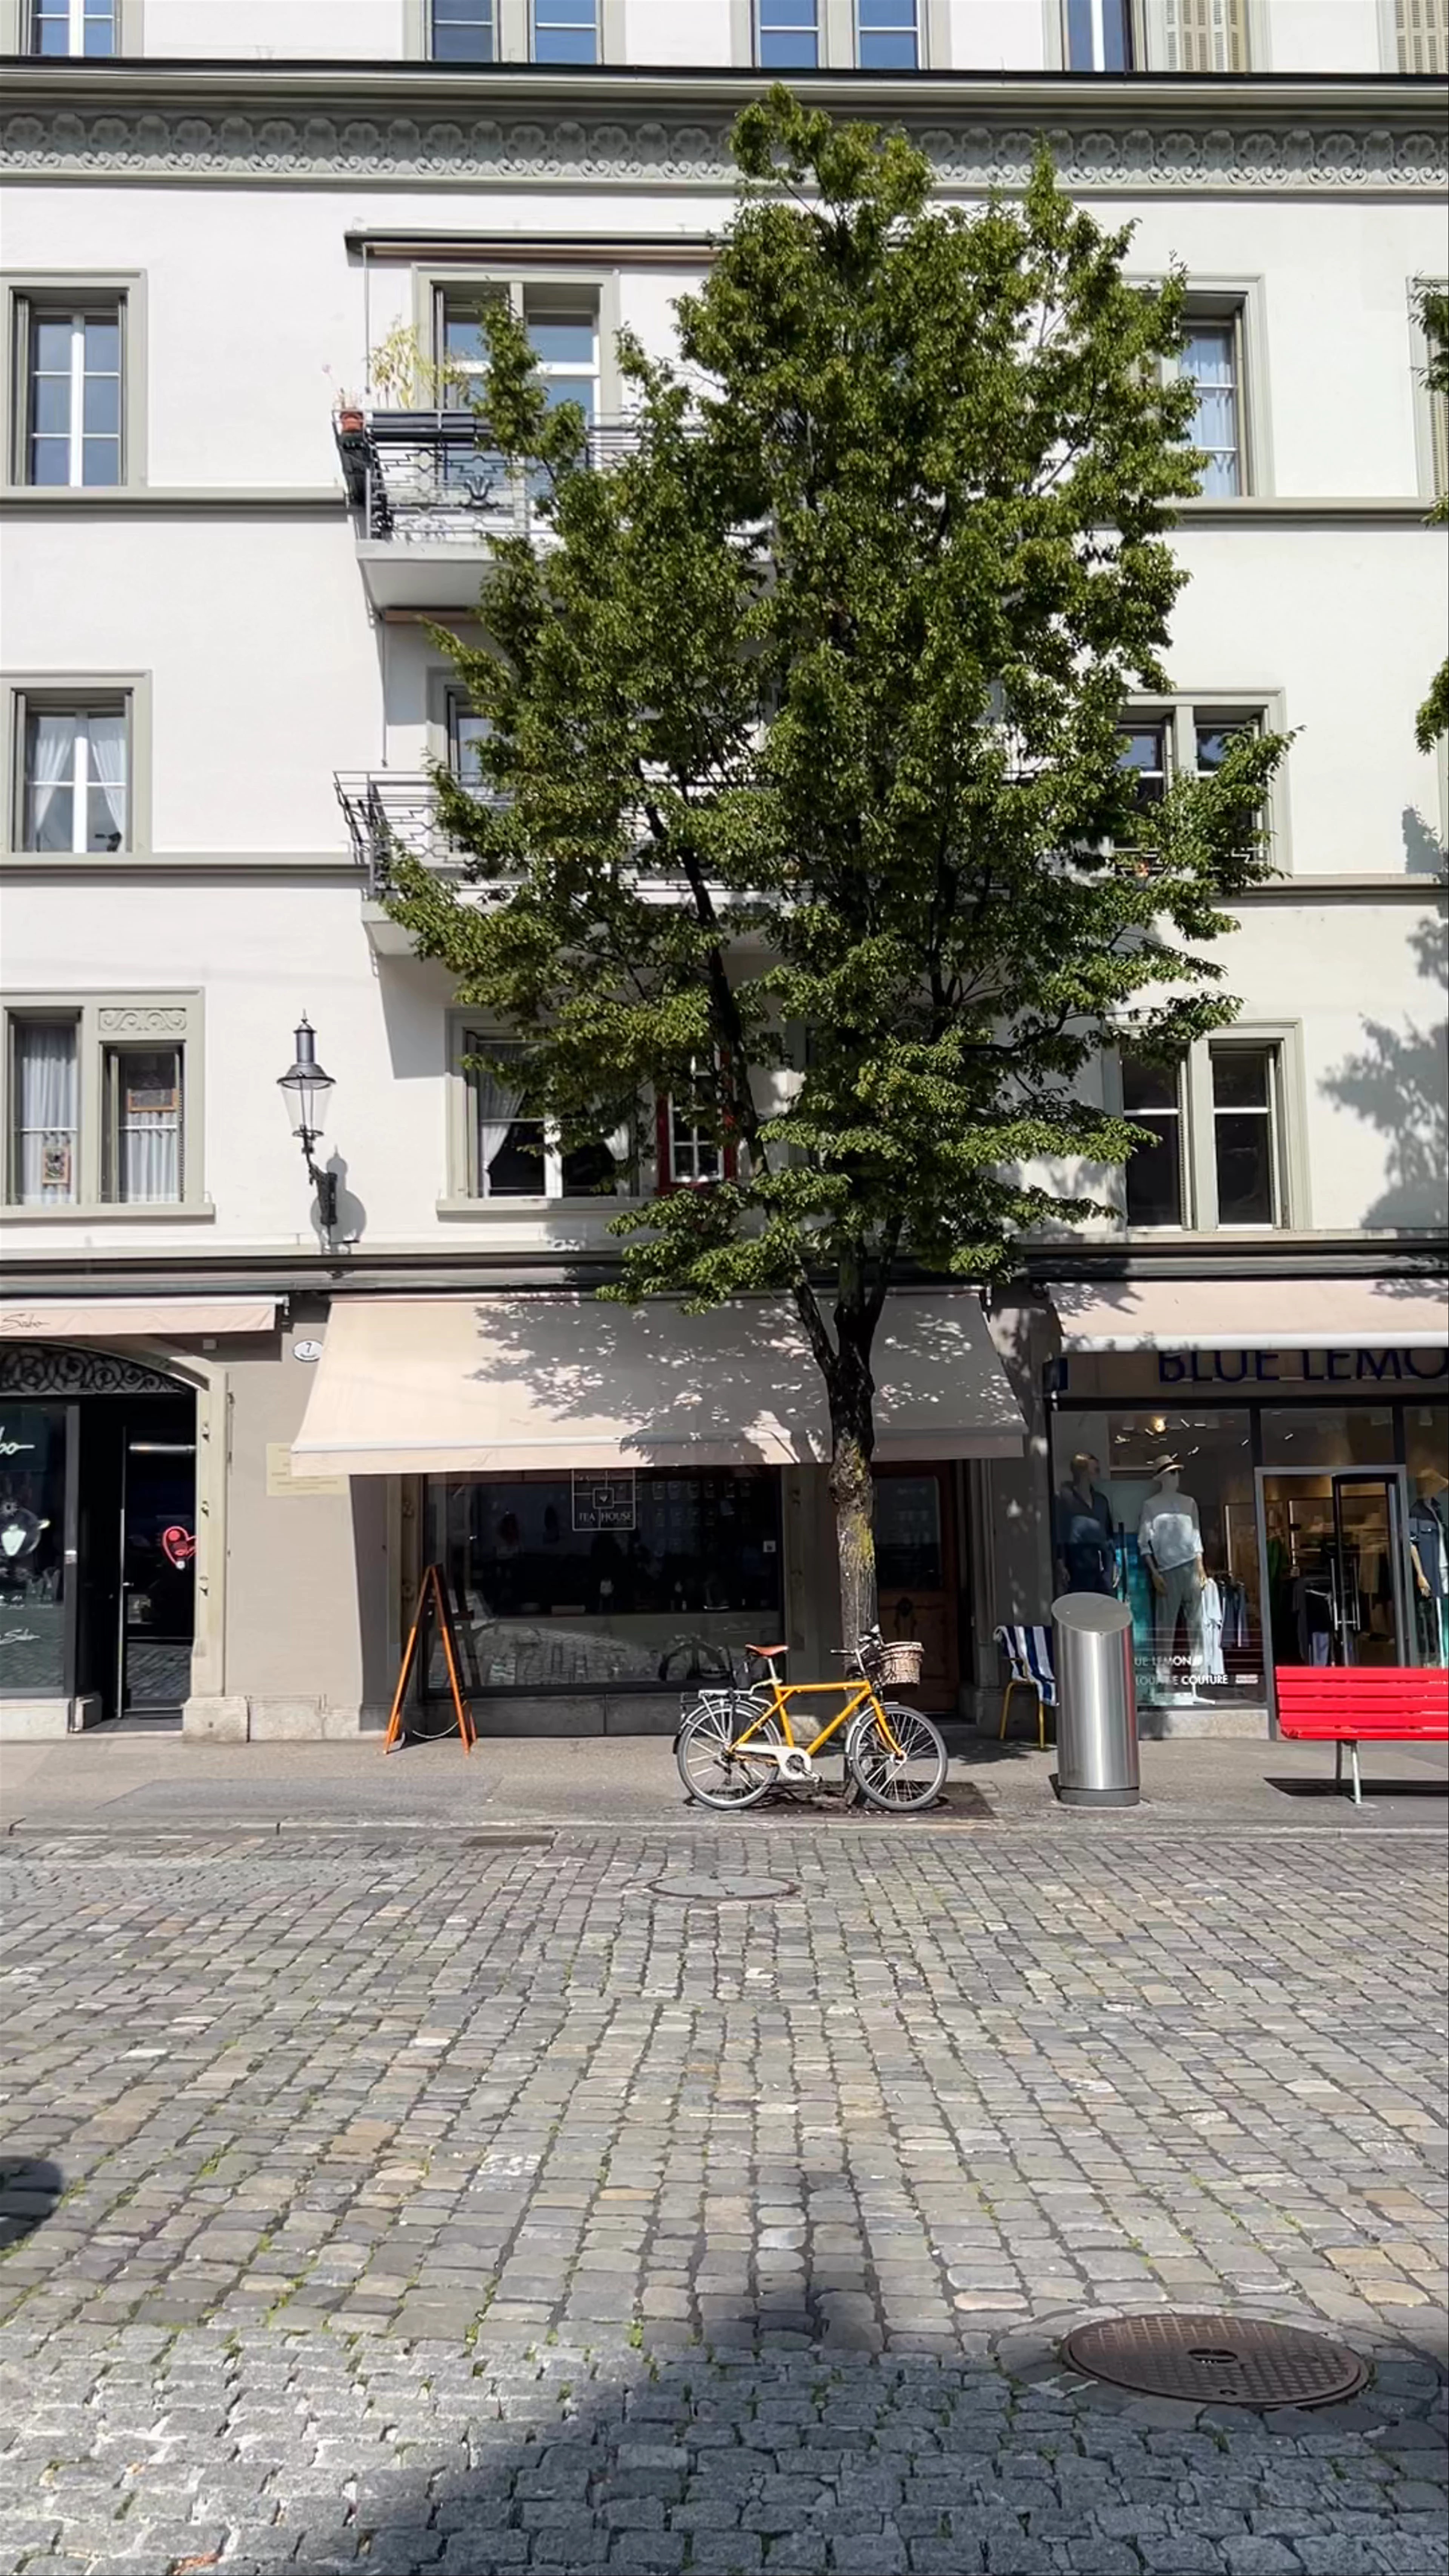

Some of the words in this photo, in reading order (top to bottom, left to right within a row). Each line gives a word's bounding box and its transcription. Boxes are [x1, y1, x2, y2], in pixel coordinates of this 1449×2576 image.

[306, 1342, 312, 1353] 7
[1158, 1350, 1280, 1383] BLUE
[1302, 1349, 1449, 1380] LEMO
[579, 1513, 595, 1522] TEA
[601, 1512, 632, 1522] HOUSE
[1181, 1675, 1229, 1685] COUTURE
